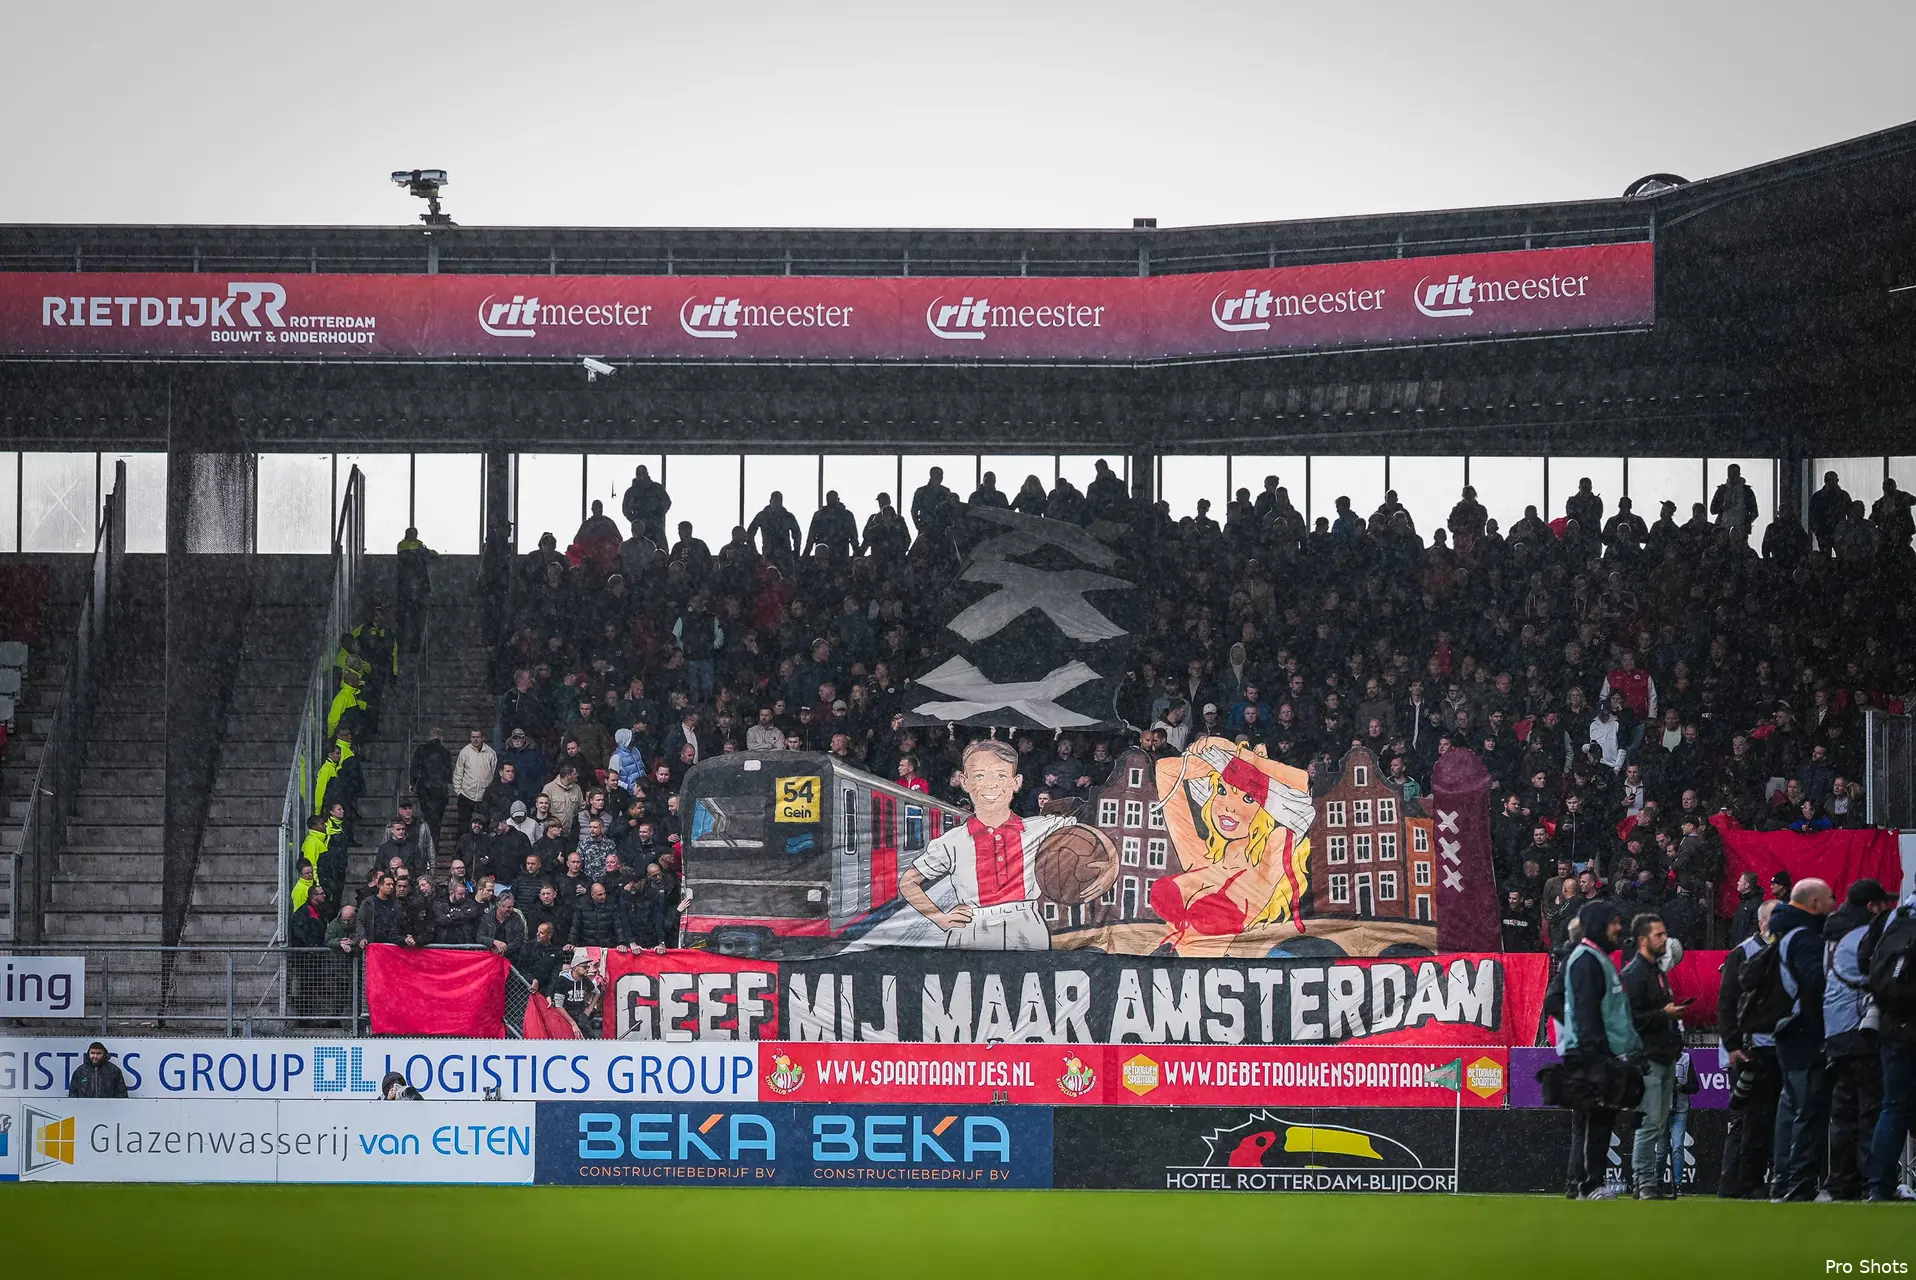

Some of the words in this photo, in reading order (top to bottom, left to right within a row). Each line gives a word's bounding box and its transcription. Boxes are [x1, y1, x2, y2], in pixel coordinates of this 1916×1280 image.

[42, 297, 235, 328] RIETDIJK
[289, 317, 376, 329] ROTTERDAM
[211, 331, 262, 343] BOUWT
[265, 331, 276, 343] &
[280, 331, 376, 344] ONDERHOUDT
[783, 780, 814, 803] 54
[783, 805, 812, 818] Gein
[7, 964, 71, 1010] ing
[615, 971, 768, 1041] GEEF
[788, 973, 899, 1041] MIJ
[921, 969, 1093, 1042] MAAR
[1109, 959, 1495, 1043] AMSTERDAM
[0, 1051, 142, 1091] GISTS
[159, 1053, 305, 1092] GROUP
[607, 1055, 754, 1095] GROUP
[816, 1060, 1035, 1087] WWW.SPARTAANTJES.NL
[90, 1122, 348, 1162] Glazenwasserij
[359, 1133, 420, 1156] van
[431, 1125, 531, 1156] ELTEN
[578, 1112, 775, 1161] BEKA
[812, 1115, 1010, 1163] BEKA
[578, 1165, 750, 1178] CONSTRUCTIEBEDRIJF
[754, 1166, 776, 1178] BV
[813, 1167, 984, 1180] CONSTRUCTIEBEDRIJF
[988, 1168, 1010, 1180] BV
[1166, 1174, 1232, 1190] HOTEL
